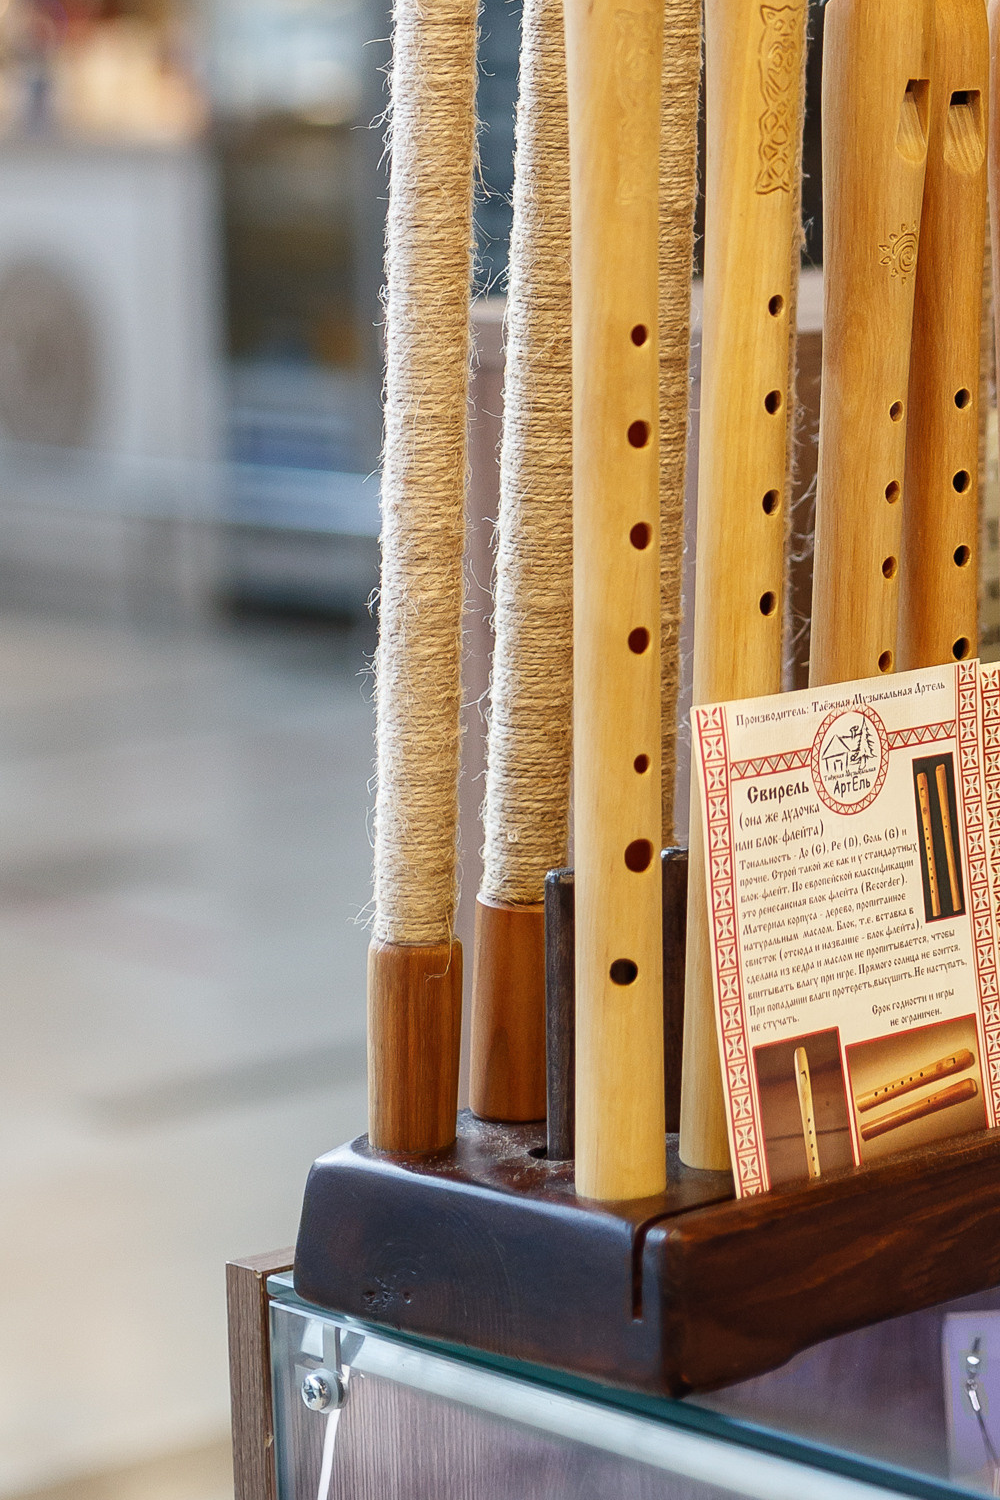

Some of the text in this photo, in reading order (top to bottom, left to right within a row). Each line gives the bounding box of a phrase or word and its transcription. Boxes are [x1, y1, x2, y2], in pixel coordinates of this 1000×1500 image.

[810, 694, 850, 713] Таёжная
[851, 683, 913, 708] Музыкальная
[913, 678, 945, 697] Артель
[746, 780, 809, 804] Свирель
[832, 775, 872, 797] АртЕль
[738, 801, 820, 830] (она же дудочка
[734, 818, 823, 852] или блок-флейта)
[738, 853, 791, 870] Тональность
[798, 847, 808, 859] До
[831, 840, 840, 851] Ре
[862, 833, 882, 844] Соль
[884, 826, 899, 841] (G)
[771, 866, 796, 880] Строй
[797, 861, 821, 874] такой
[822, 860, 833, 869] же
[835, 856, 849, 866] как
[850, 855, 855, 863] и
[857, 853, 862, 864] у
[864, 842, 917, 860] стандартных
[791, 880, 802, 892] По
[804, 870, 852, 889] европейской
[854, 859, 913, 878] классификации
[742, 909, 756, 919] это
[808, 894, 826, 904] блок
[828, 887, 858, 902] флейта
[742, 919, 785, 935] Материал
[787, 912, 817, 926] корпуса
[855, 892, 905, 911] пропитанное
[743, 932, 798, 951] натуральным
[875, 908, 907, 922] вставка
[908, 906, 914, 914] в
[744, 953, 776, 967] свисток
[779, 945, 813, 961] (отсюда
[814, 943, 820, 951] и
[821, 935, 858, 950] название
[866, 929, 884, 940] блок
[746, 969, 778, 984] сделана
[779, 967, 790, 976] из
[791, 961, 814, 973] кедра
[816, 959, 821, 967] и
[823, 952, 853, 966] маслом
[854, 950, 863, 958] не
[930, 929, 954, 940] чтобы
[747, 983, 794, 1000] впитывать
[796, 976, 818, 988] влагу
[820, 973, 834, 984] при
[858, 959, 891, 975] Прямого
[893, 953, 919, 965] солнца
[920, 950, 930, 959] не
[749, 1004, 765, 1017] При
[766, 995, 807, 1011] попадании
[808, 990, 830, 1002] влаги
[871, 988, 954, 1016] Срок годности и игры
[750, 1023, 760, 1032] не
[889, 1017, 899, 1026] не
